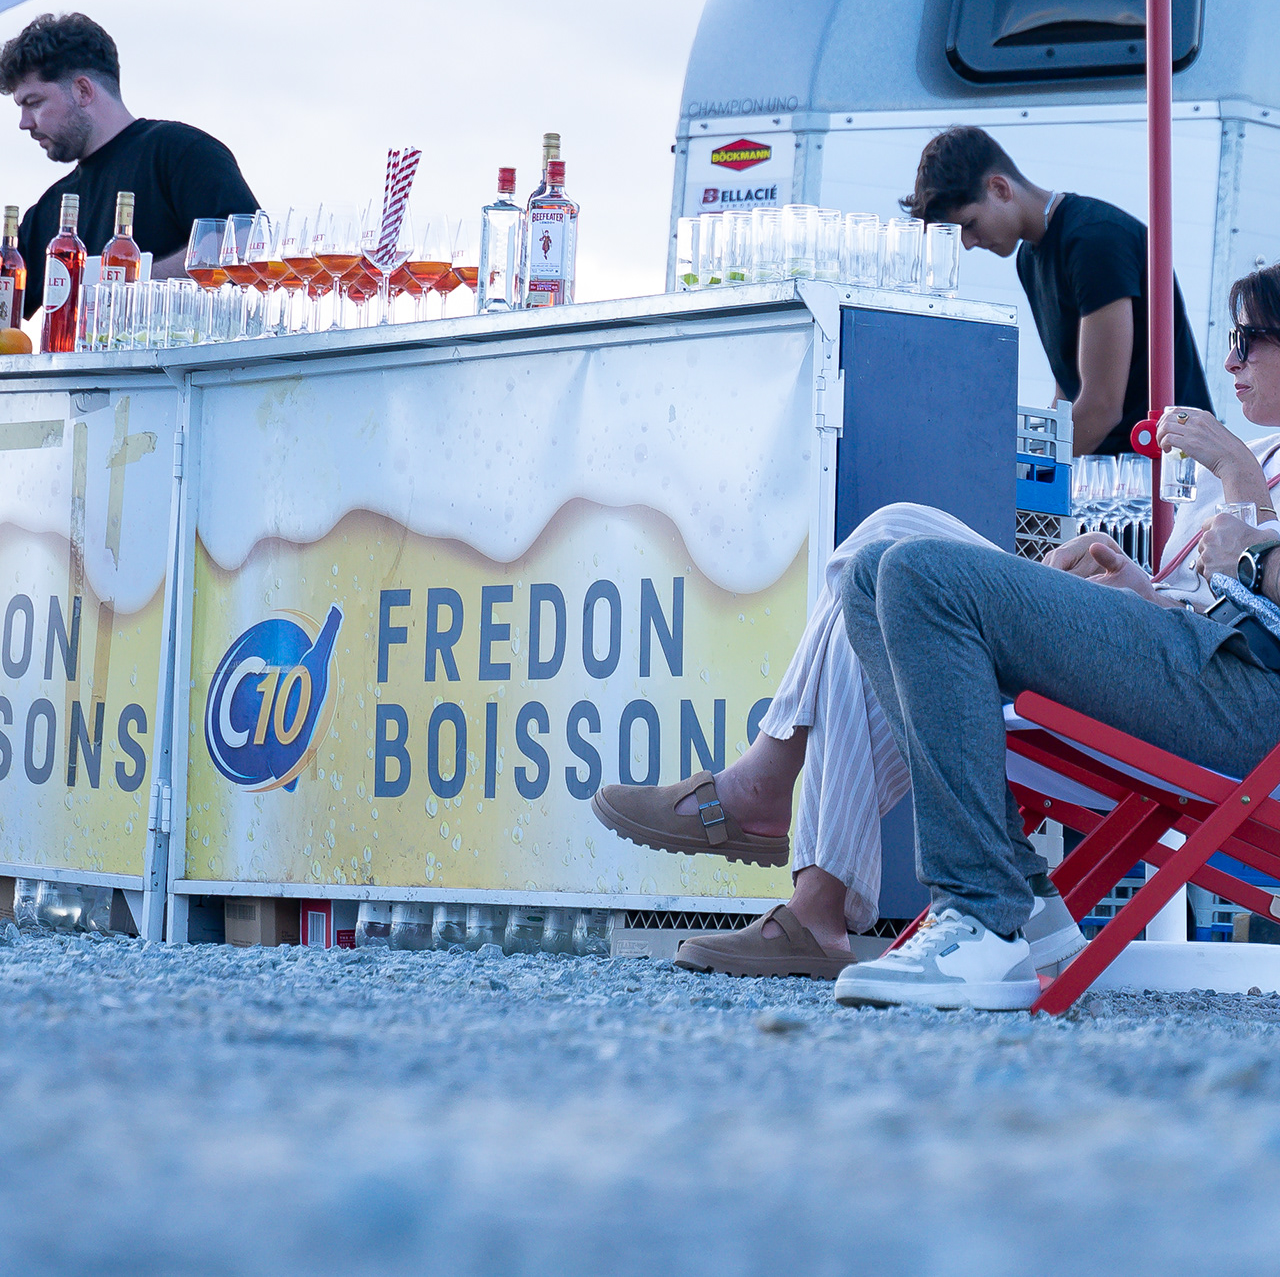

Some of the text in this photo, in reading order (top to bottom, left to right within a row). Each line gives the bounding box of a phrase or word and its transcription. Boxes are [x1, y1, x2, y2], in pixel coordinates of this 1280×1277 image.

[688, 95, 799, 118] CHAMPION UNO
[712, 149, 770, 163] BÖCKMANN
[702, 184, 778, 205] BELLACIÉ
[532, 212, 564, 223] BEEFEATER
[377, 576, 685, 683] FREDON
[220, 655, 312, 748] C10
